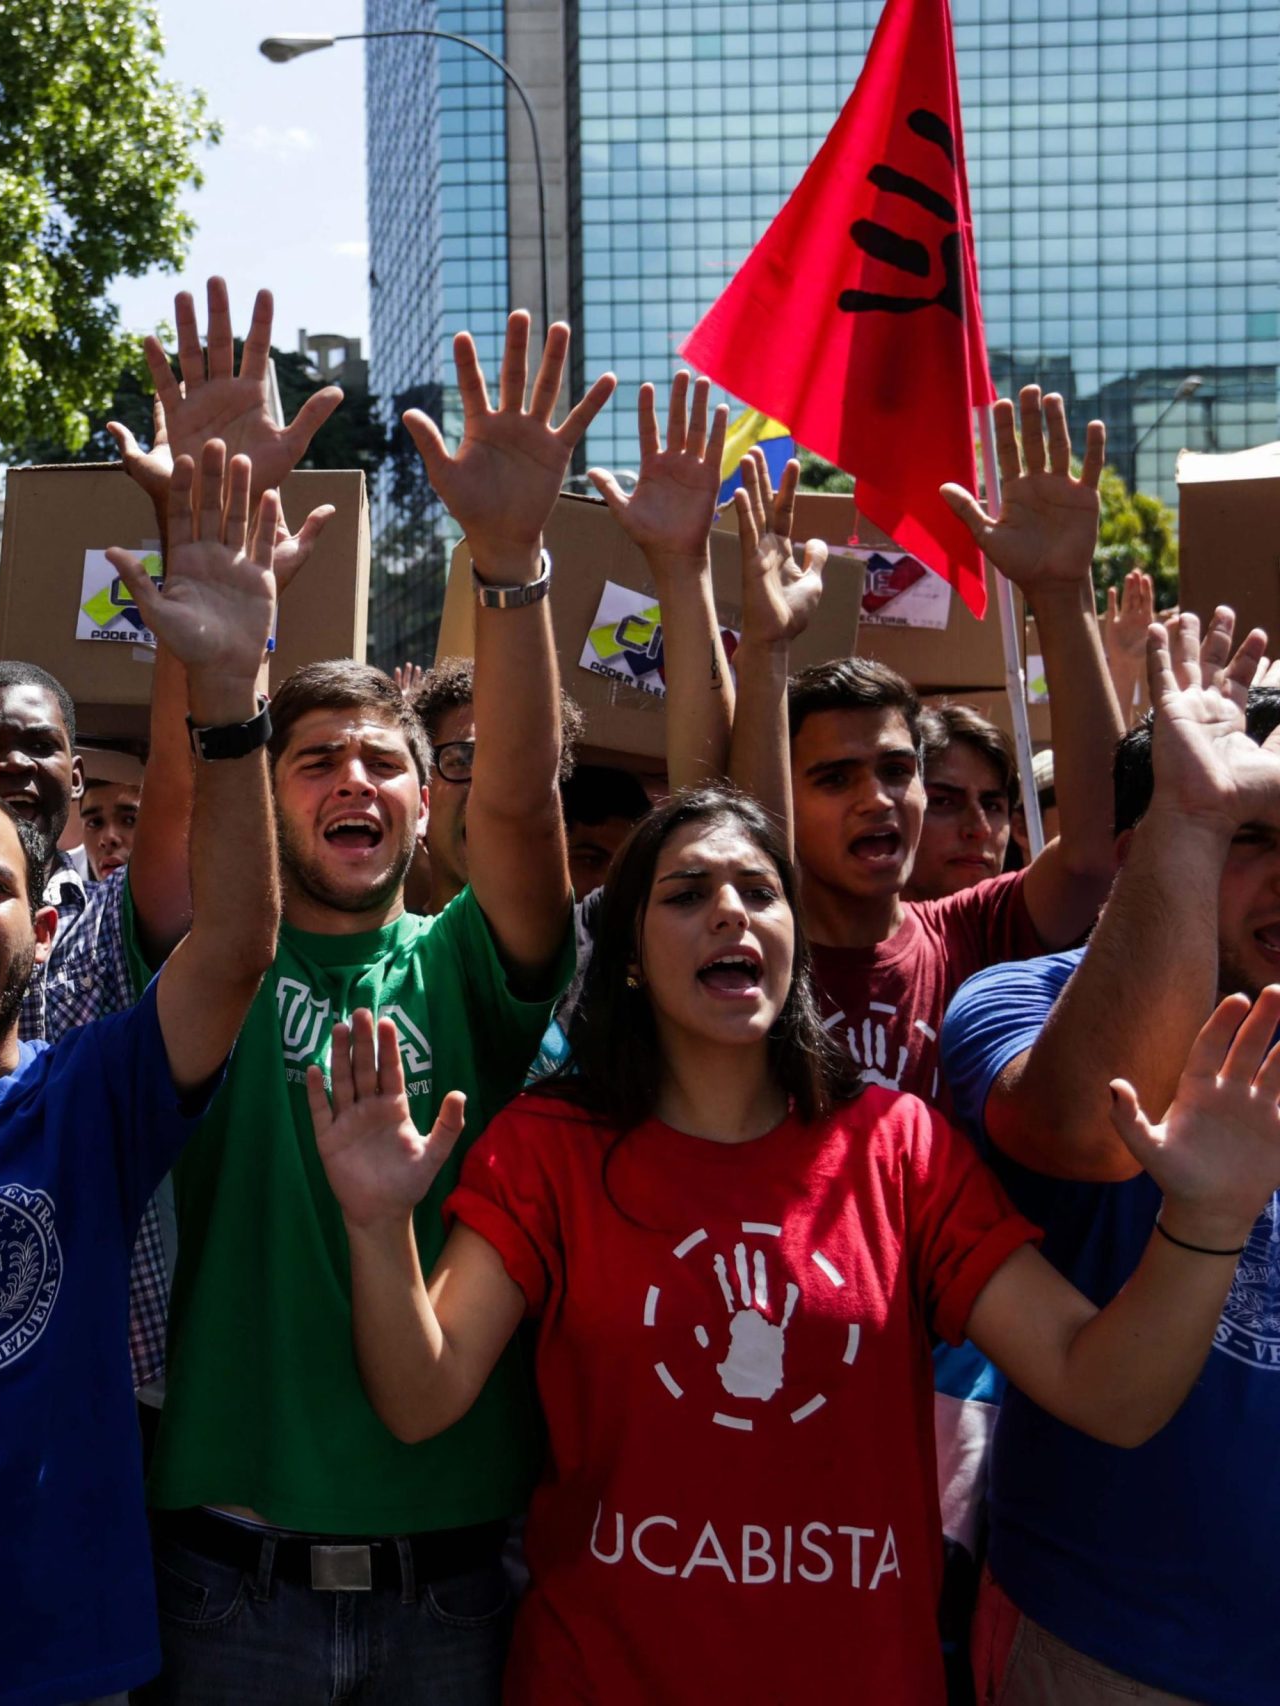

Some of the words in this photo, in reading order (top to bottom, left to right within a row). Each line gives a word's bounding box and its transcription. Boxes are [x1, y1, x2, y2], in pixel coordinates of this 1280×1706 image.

[90, 629, 138, 641] PODER
[590, 661, 634, 686] PODER
[589, 1499, 902, 1591] UCABISTA
